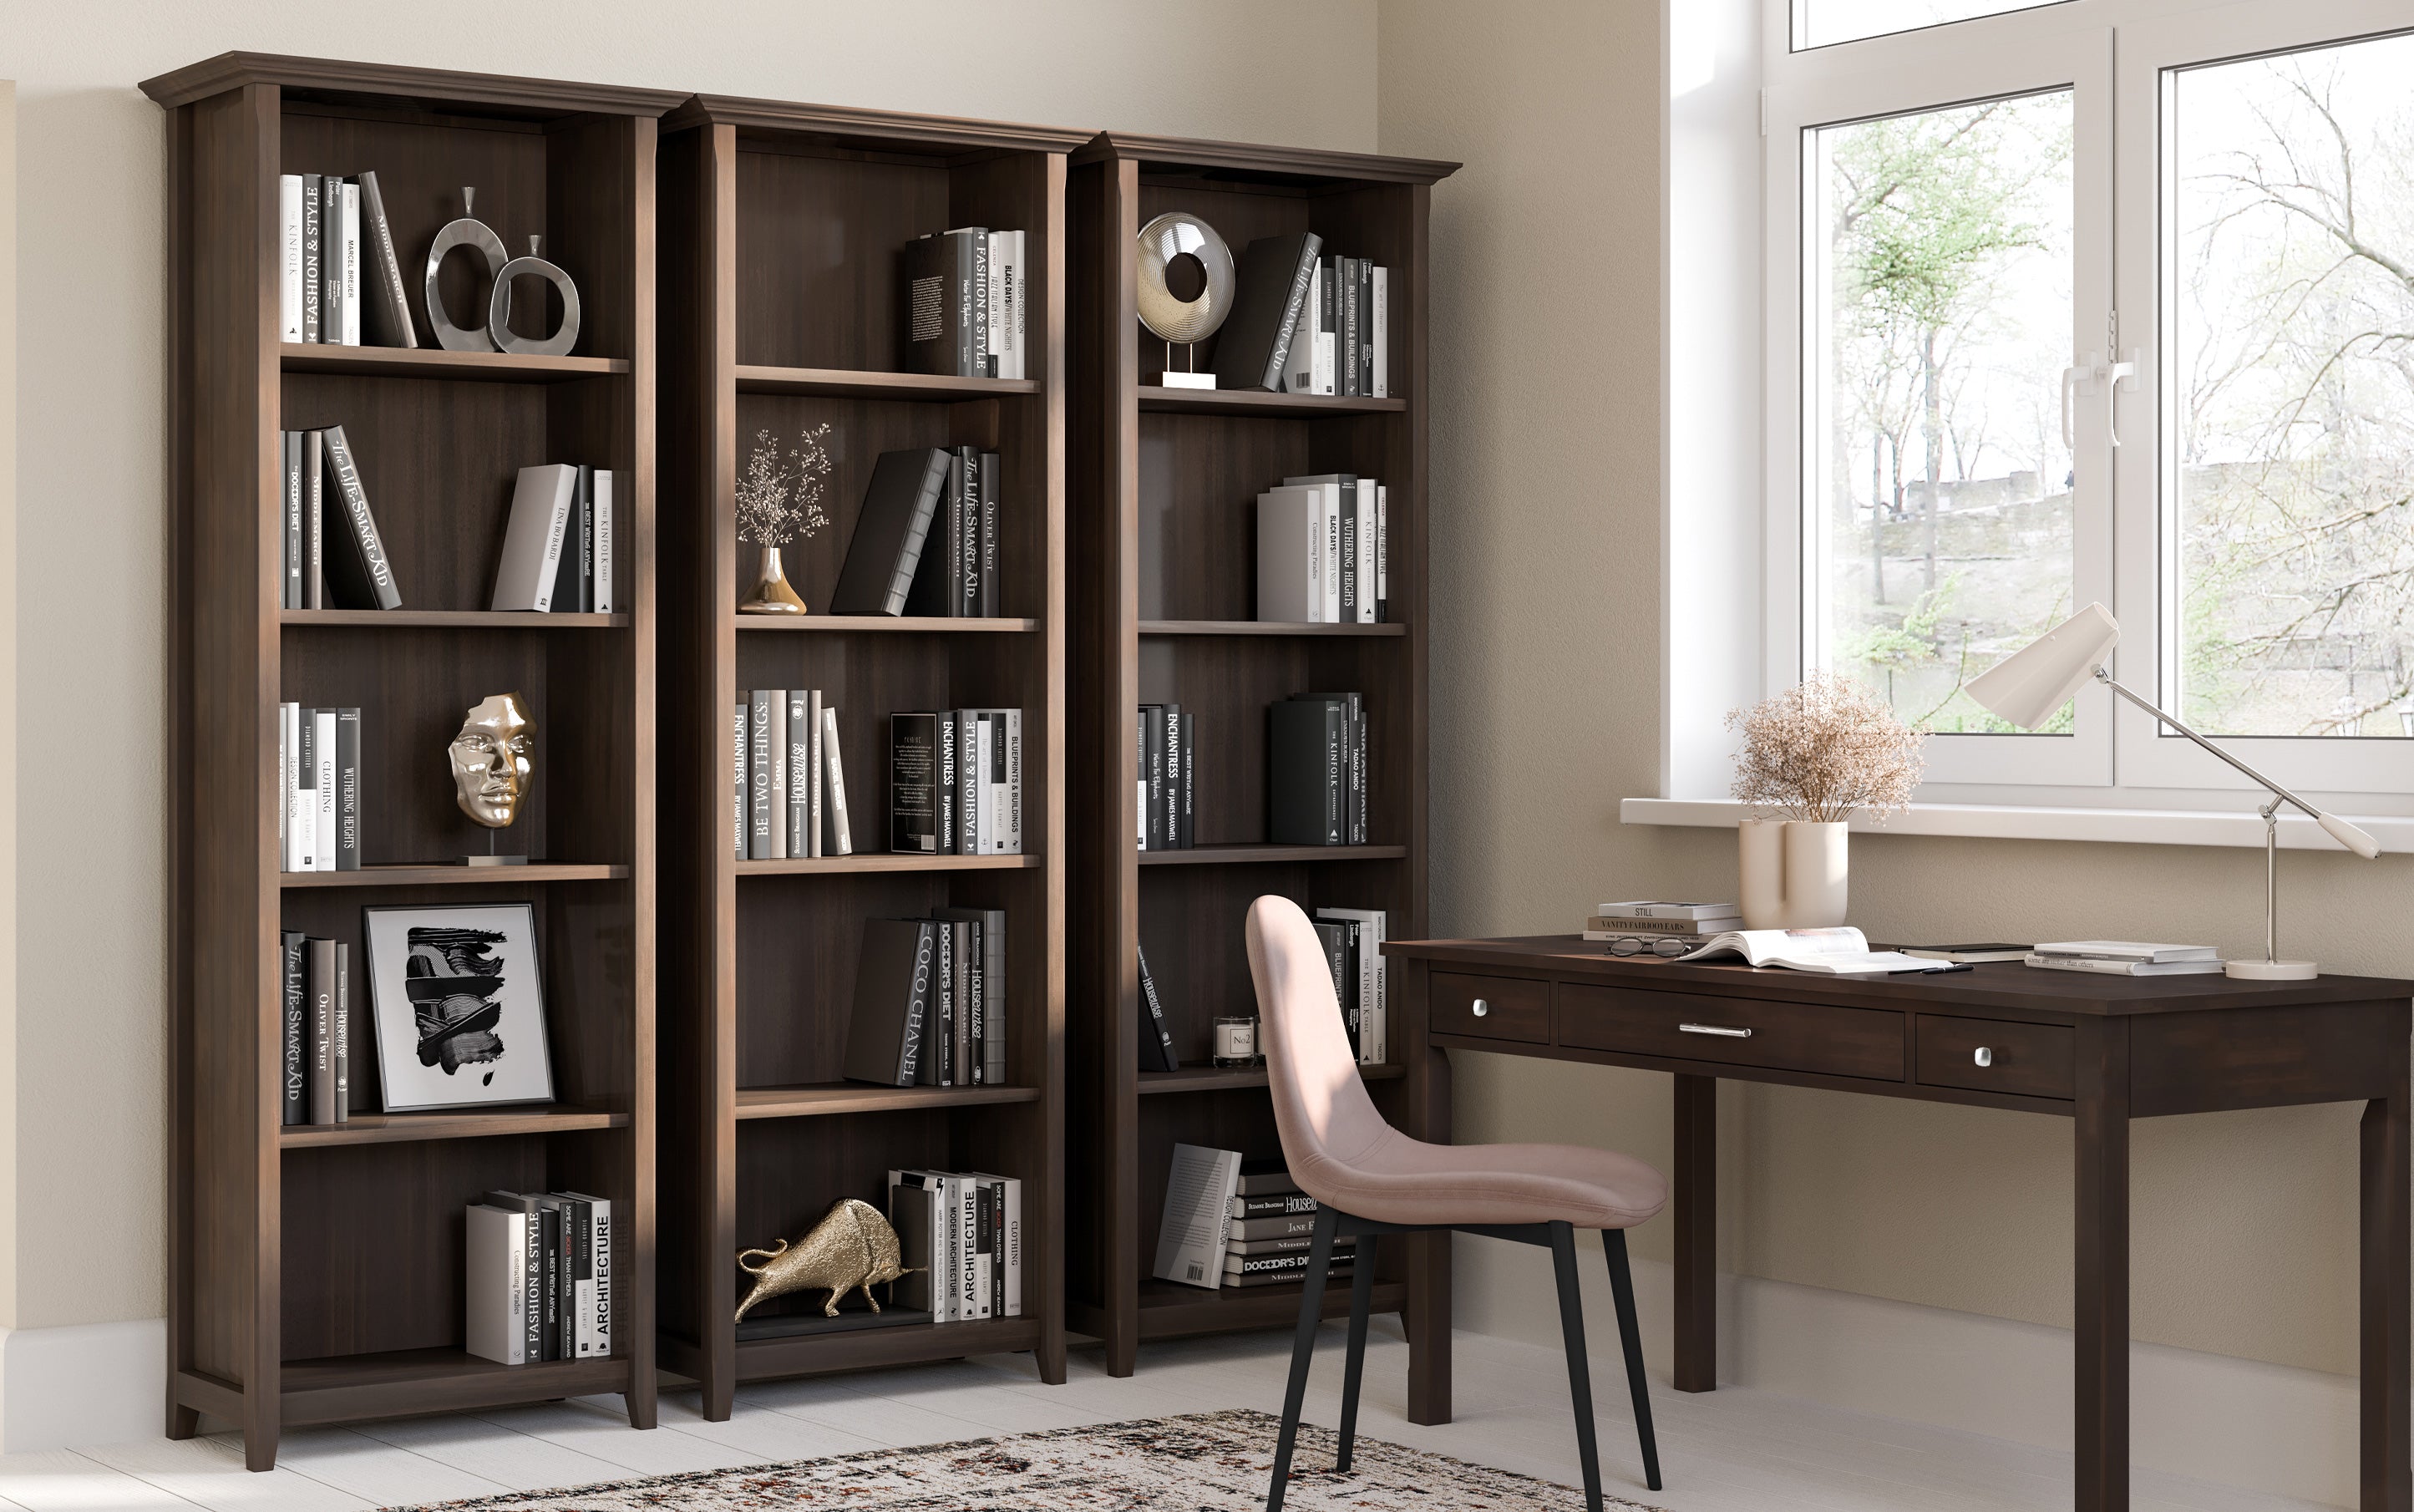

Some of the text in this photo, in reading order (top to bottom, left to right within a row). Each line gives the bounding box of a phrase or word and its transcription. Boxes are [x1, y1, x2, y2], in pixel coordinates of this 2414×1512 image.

[289, 225, 297, 276] KINFOLK
[307, 187, 317, 325] FASHION & STYLE
[378, 216, 403, 303] MIDDLEMARCH
[1304, 246, 1317, 265] The
[961, 303, 971, 327] Elephants
[977, 246, 986, 369] FASHION & STYLE
[332, 440, 347, 465] The
[966, 458, 977, 480] The
[549, 507, 565, 561] LINA BO BARDI
[986, 502, 995, 571] OLIVER TWIST
[1344, 517, 1354, 606] WUTHERING HEIGHTS
[965, 563, 978, 598] KID
[735, 715, 744, 784] ENCHANTRESS
[756, 702, 768, 837] BE TWO THINGS:
[791, 743, 806, 804] Housewise
[943, 721, 953, 786] ENCHANTRESS
[1168, 714, 1178, 778] ENCHANTRESS
[344, 767, 354, 849] WUTHERING HEIGHTS
[966, 721, 975, 836] FASHION & STYLE
[1151, 776, 1160, 799] Elephants
[1635, 908, 1653, 917] STILL
[1659, 922, 1684, 930] YEARS
[289, 945, 302, 971] The
[942, 992, 951, 1020] DIET
[972, 970, 982, 1039] Housewise
[1143, 977, 1162, 1019] Housewise
[319, 993, 329, 1071] OLIVER TWIST
[336, 1010, 347, 1058] Housewise
[902, 999, 924, 1081] CHANEL
[287, 1065, 302, 1101] KID
[965, 1191, 974, 1301] ARCHITECTURE
[1220, 1195, 1235, 1246] DESIGN COLLECTION
[1288, 1223, 1306, 1232] JANE
[529, 1213, 539, 1341] FASHION & STYLE
[597, 1216, 608, 1334] ARCHITECTURE
